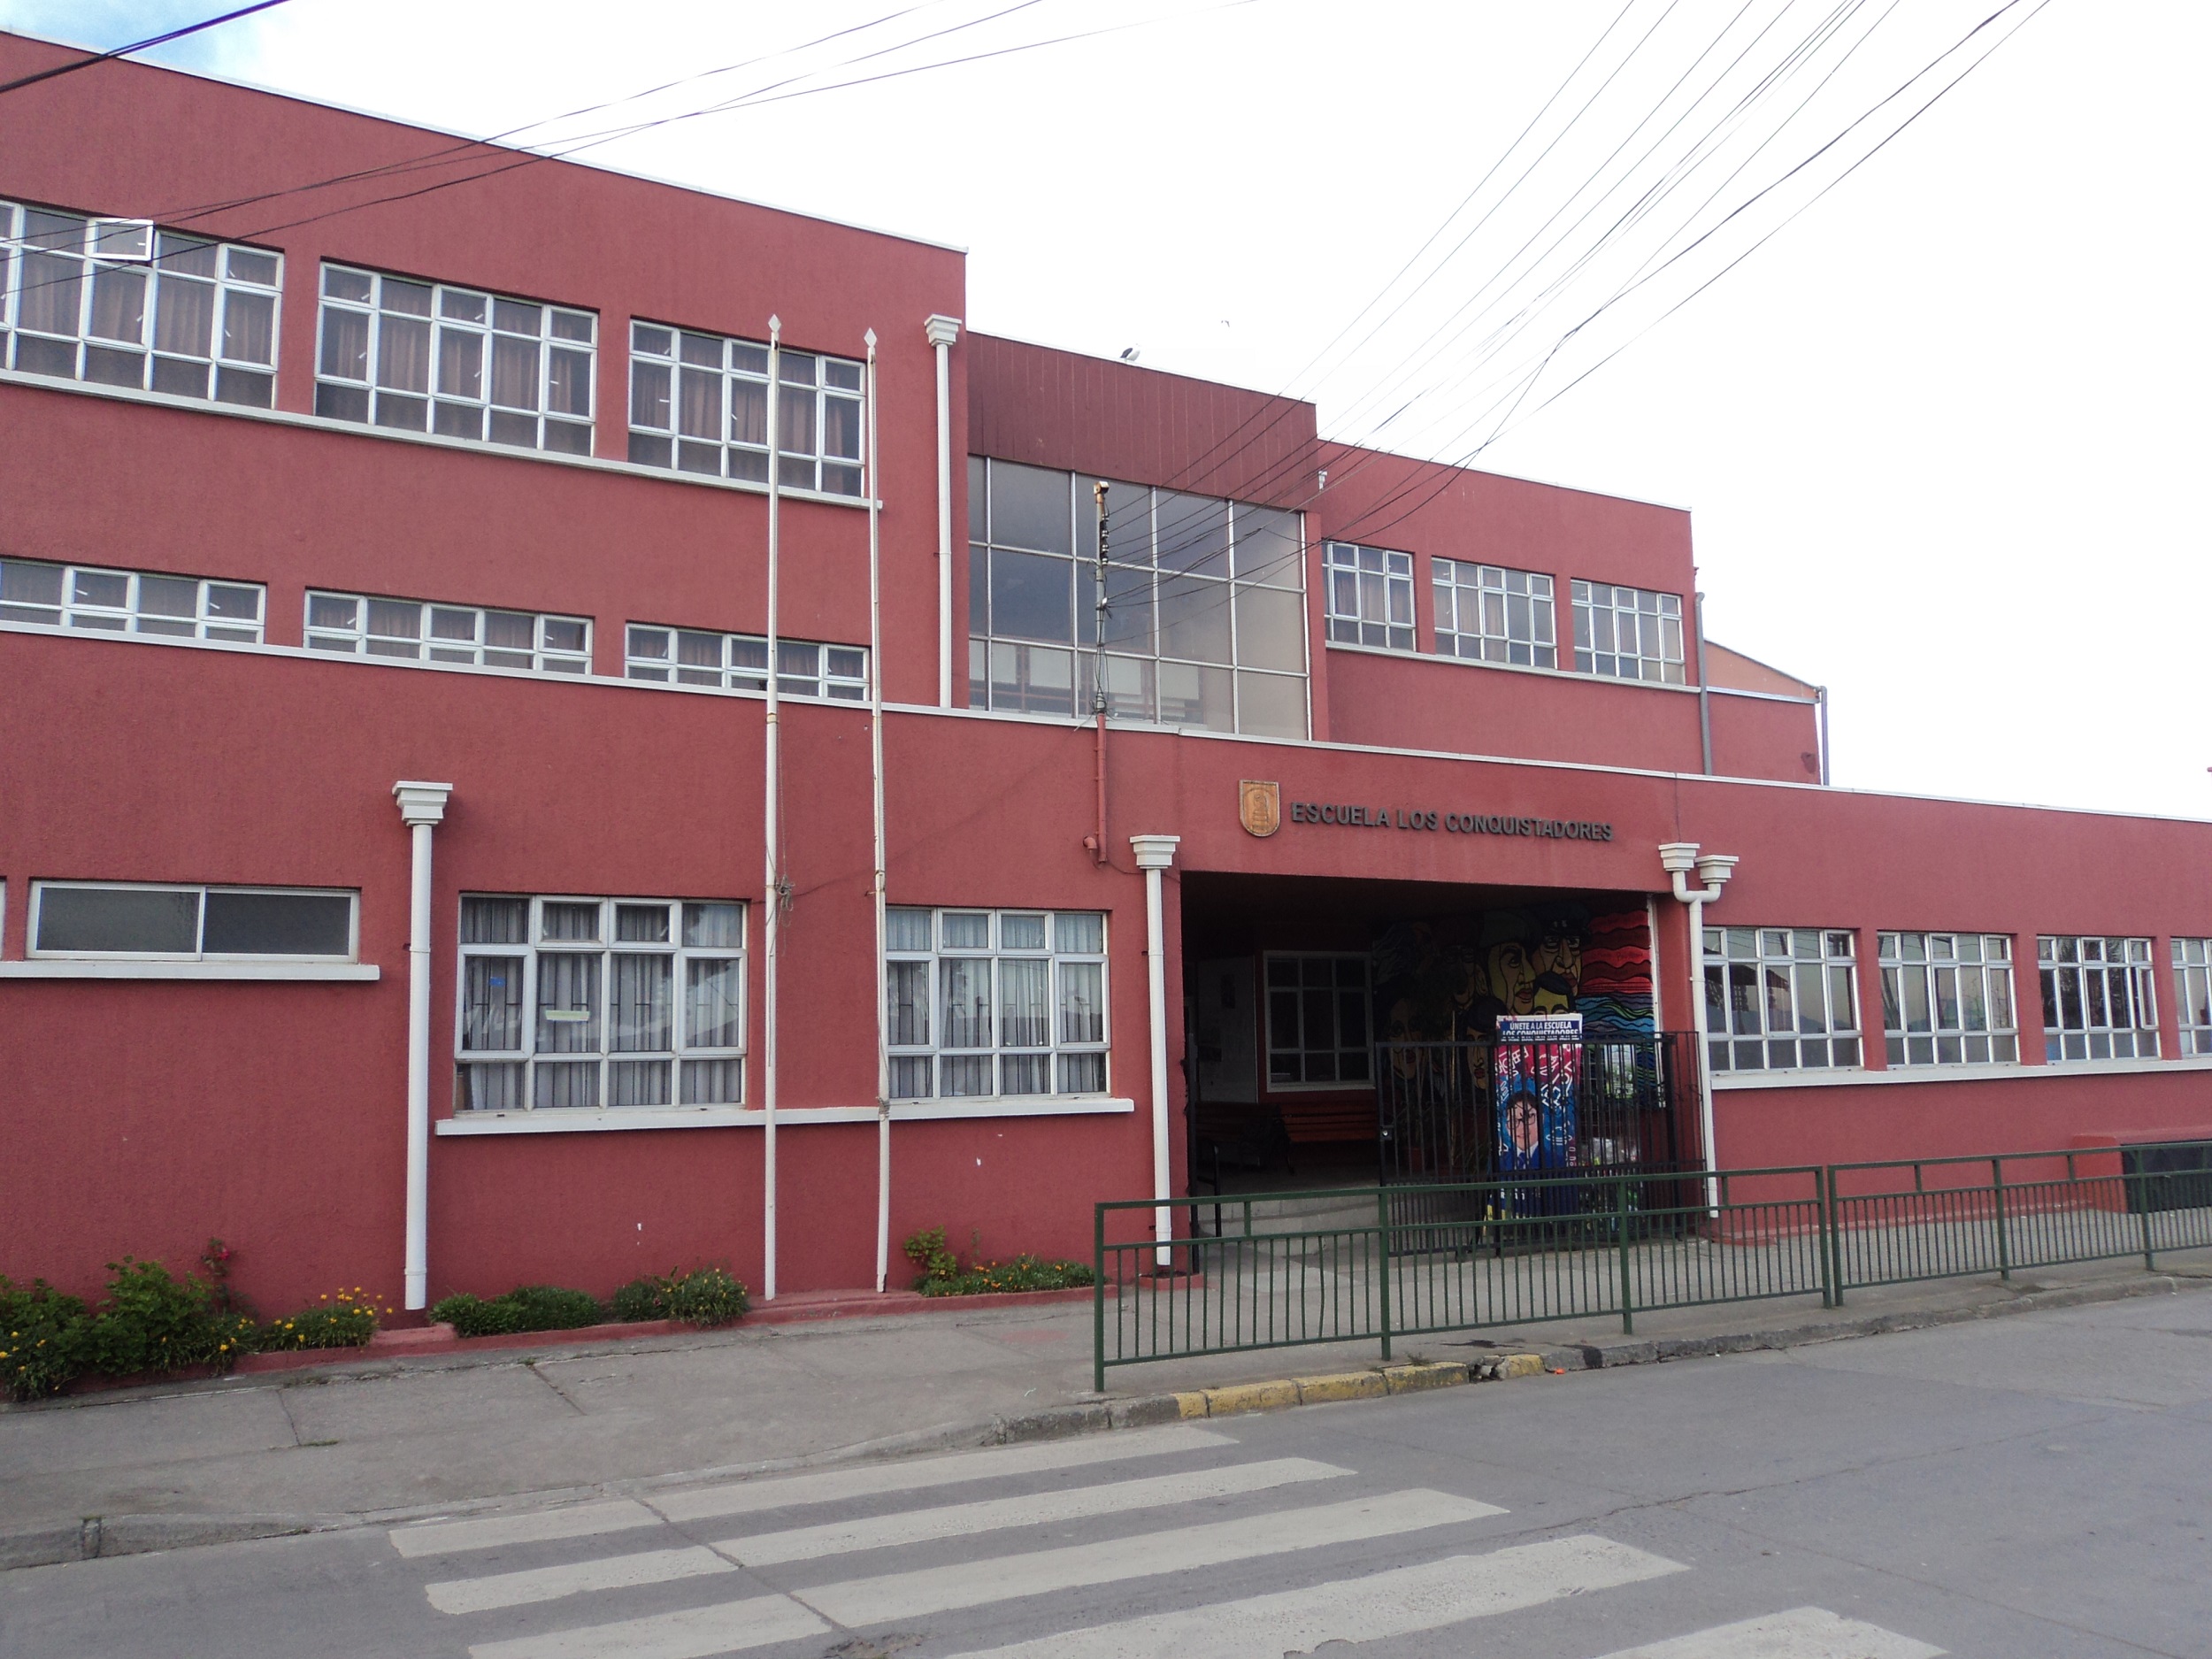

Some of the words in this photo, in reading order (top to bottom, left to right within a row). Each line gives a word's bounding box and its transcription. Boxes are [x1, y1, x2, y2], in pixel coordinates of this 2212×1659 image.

[1291, 802, 1390, 827] ESCUELA
[1397, 810, 1439, 830] LOS
[1445, 812, 1613, 841] CONQUISTADORES
